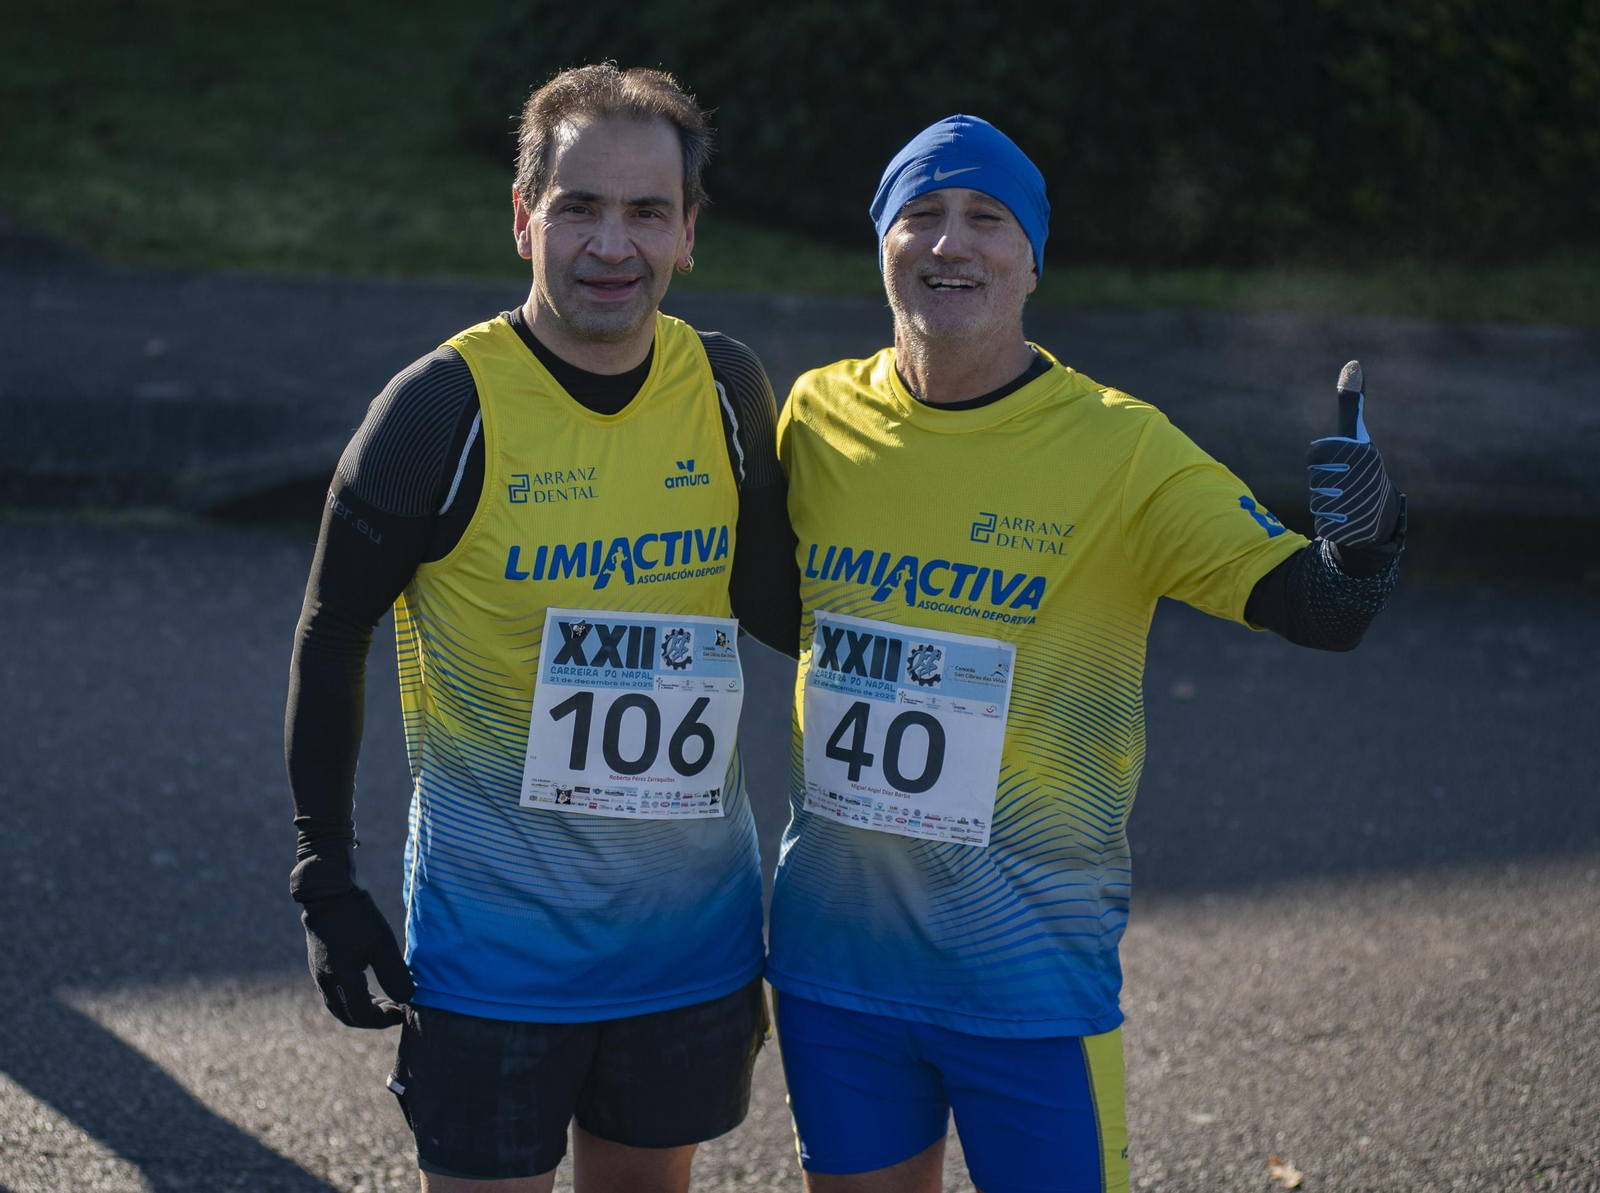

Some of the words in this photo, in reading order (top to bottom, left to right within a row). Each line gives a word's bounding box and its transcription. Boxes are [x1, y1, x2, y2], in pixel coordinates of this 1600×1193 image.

[532, 467, 597, 486] ARRANZ
[665, 472, 710, 489] amura
[534, 486, 600, 503] DENTAL
[999, 516, 1075, 538] ARRANZ
[996, 533, 1069, 556] DENTAL
[504, 525, 729, 590] LIMIACTIVA
[637, 568, 694, 584] ASOCIACIÓN
[804, 543, 1047, 611] LIMIACTIVA
[917, 600, 981, 618] ASOCIACIÓN
[982, 608, 1037, 625] DEPORTIVA
[552, 621, 656, 670] XXII
[818, 625, 903, 683] XXII
[550, 666, 599, 677] CARREIRA
[604, 669, 617, 678] DO
[621, 670, 653, 680] NADAL
[955, 665, 976, 674] Concello
[966, 672, 984, 681] Cibrao
[574, 678, 618, 686] decembro
[850, 677, 862, 686] DO
[865, 678, 896, 693] NADAL
[863, 688, 873, 696] de
[874, 691, 896, 700] 2025
[549, 691, 715, 777] 106
[825, 701, 946, 794] 40
[609, 774, 631, 782] Roberto
[631, 774, 647, 783] Pérez
[647, 776, 675, 784] Zarraquiños
[851, 783, 867, 792] Miguel
[895, 791, 911, 799] Barba
